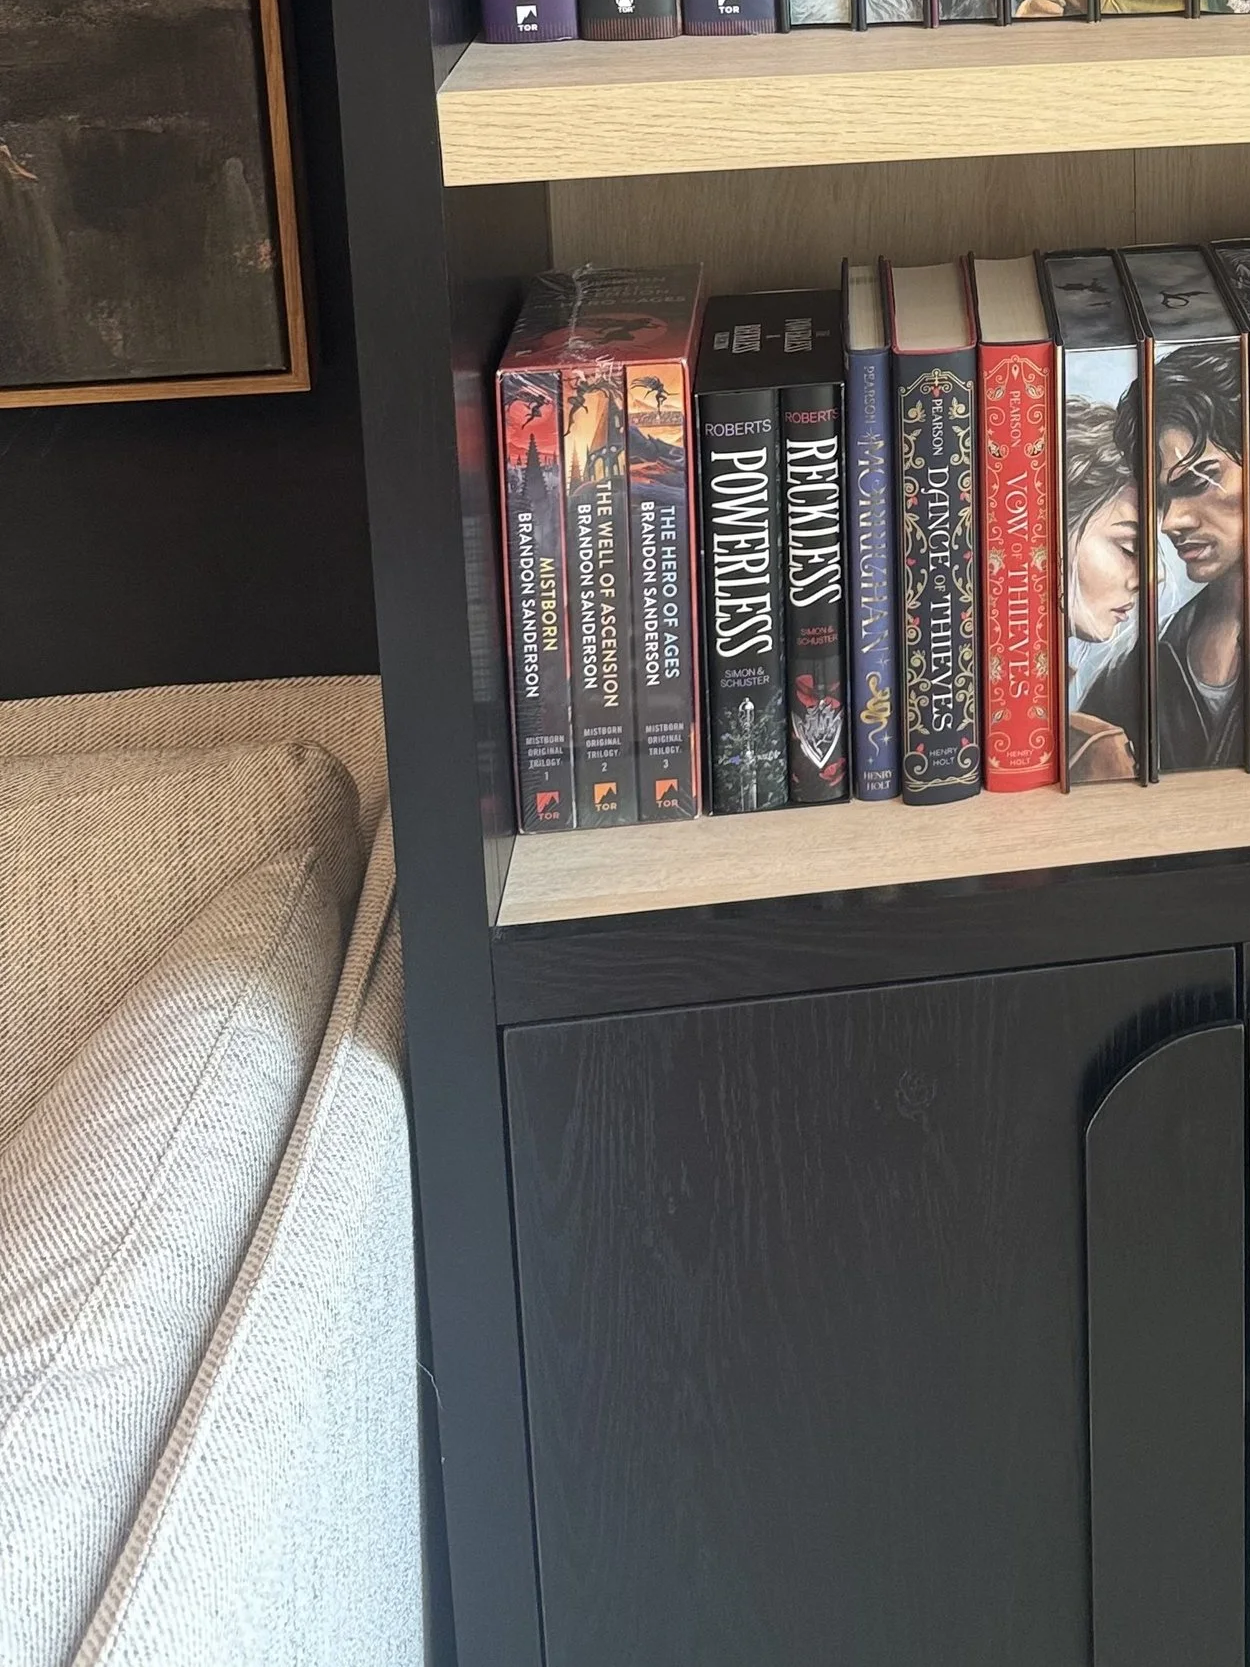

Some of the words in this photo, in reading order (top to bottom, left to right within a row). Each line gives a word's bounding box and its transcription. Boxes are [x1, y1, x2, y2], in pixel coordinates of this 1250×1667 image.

[718, 5, 739, 14] TOR
[518, 24, 538, 32] TOR
[864, 366, 876, 424] PEARSON
[785, 409, 840, 423] ROBERTS
[1009, 390, 1022, 448] PEARSON
[705, 419, 772, 437] ROBERTS
[931, 399, 943, 456] PEARSON
[597, 481, 612, 516] THE
[1005, 470, 1029, 540] VOW
[660, 506, 676, 541] THE
[786, 435, 842, 607] RECKLESS
[920, 466, 952, 570] DANCE
[577, 504, 594, 587] BRANDON
[598, 522, 614, 569] WELL
[641, 501, 657, 585] BRANDON
[711, 446, 773, 657] POWERLESS
[857, 434, 889, 654] MORRIGHAN
[1011, 542, 1023, 559] OF
[518, 512, 535, 595] BRANDON
[661, 546, 678, 598] HERO
[599, 573, 615, 598] OF
[933, 575, 946, 592] OF
[539, 557, 558, 651] MISTBORN
[663, 603, 679, 627] OF
[643, 587, 660, 686] SANDERSON
[1007, 562, 1030, 698] THIEVES
[522, 599, 539, 698] SANDERSON
[580, 590, 598, 690] SANDERSON
[797, 635, 838, 646] SCHUSTER
[600, 603, 619, 708] ASCENSION
[664, 632, 680, 679] AGES
[930, 592, 953, 732] THIEVES
[720, 676, 770, 688] SCHUSTER
[725, 669, 756, 678] SIMON
[584, 726, 622, 736] MISTBORN
[645, 723, 684, 733] MISTBORN
[526, 735, 565, 745] MISTBORN
[586, 738, 621, 747] ORIGINAL
[647, 735, 683, 744] ORIGINAL
[528, 747, 564, 756] ORIGINAL
[929, 747, 957, 757] HENRY
[1006, 749, 1033, 758] HENRY
[602, 762, 608, 772] 2
[663, 759, 669, 769] 3
[933, 757, 955, 766] HOLT
[1010, 757, 1031, 766] HOLT
[864, 770, 892, 780] HENRY
[866, 780, 891, 790] HOLT
[595, 803, 617, 812] TOR
[656, 799, 679, 808] TOR
[538, 812, 560, 820] TOR
